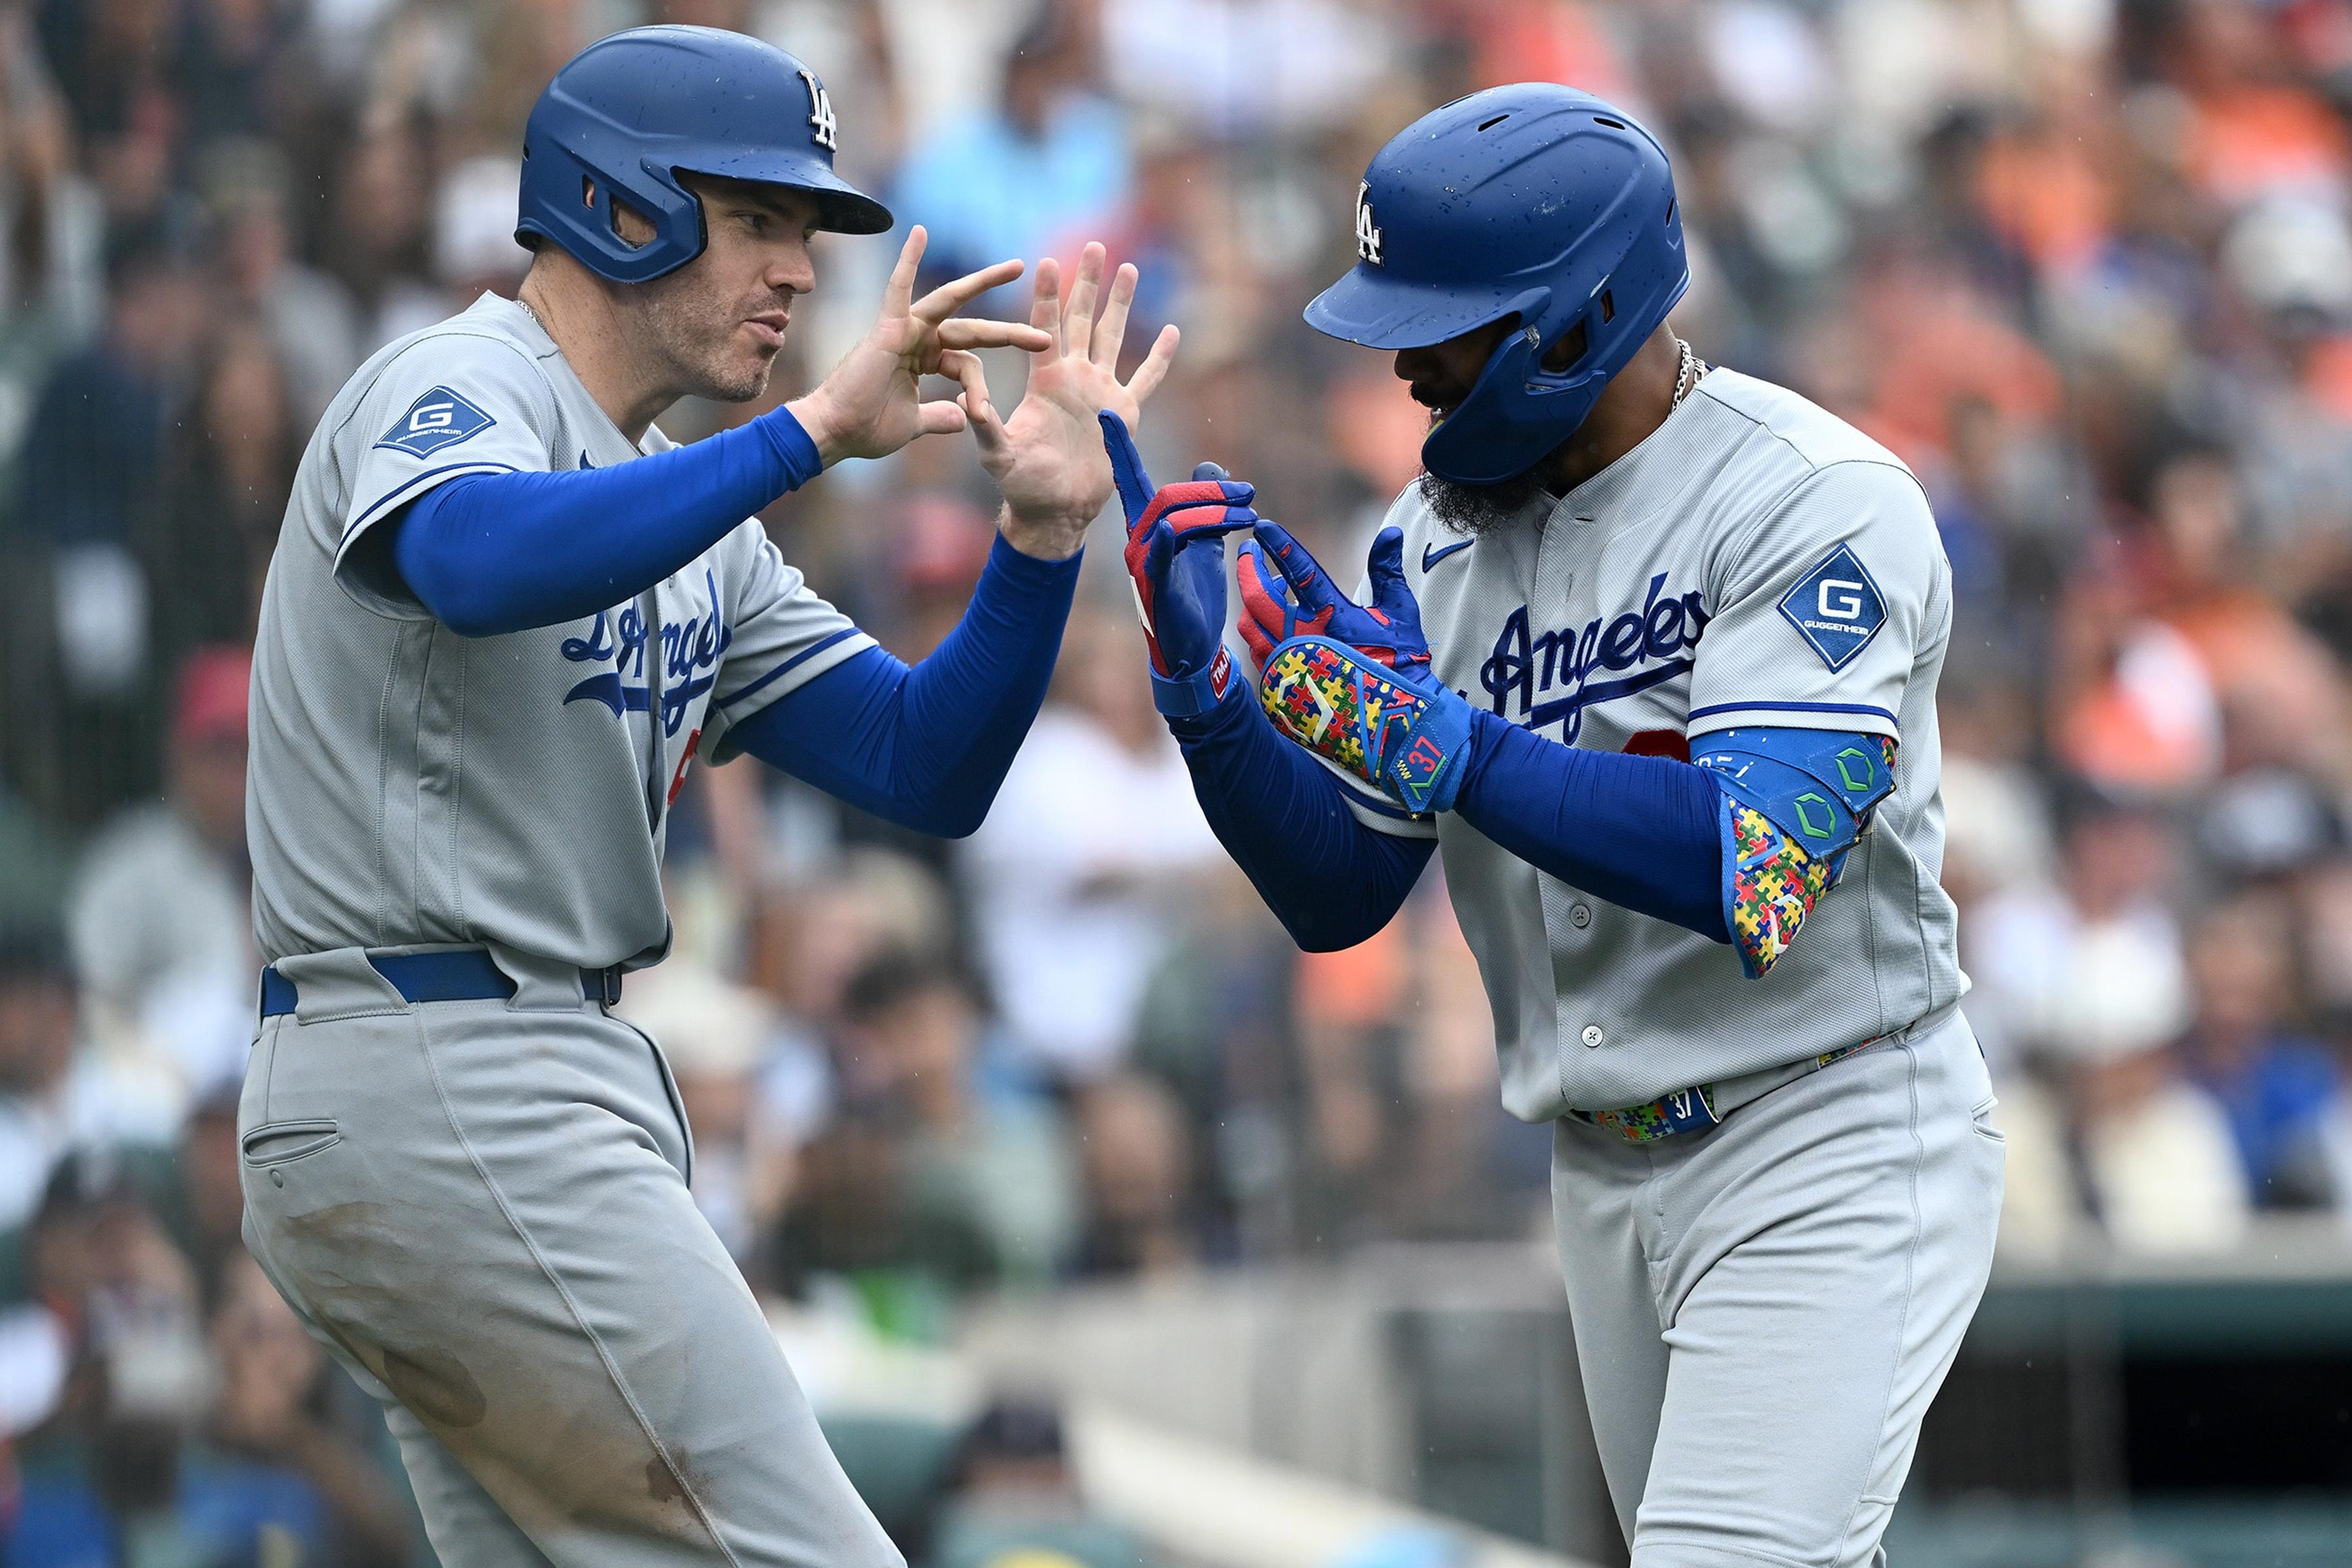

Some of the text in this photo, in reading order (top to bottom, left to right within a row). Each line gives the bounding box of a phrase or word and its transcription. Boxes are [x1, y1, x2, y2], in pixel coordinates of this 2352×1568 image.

[796, 69, 837, 151] LA
[1356, 180, 1382, 265] LA
[408, 402, 454, 431] G
[1818, 579, 1863, 619] G
[1804, 621, 1869, 635] GUGGENHEIM
[1480, 571, 1713, 746] Angeles
[1409, 736, 1442, 772] 37
[1669, 1088, 1692, 1119] 37
